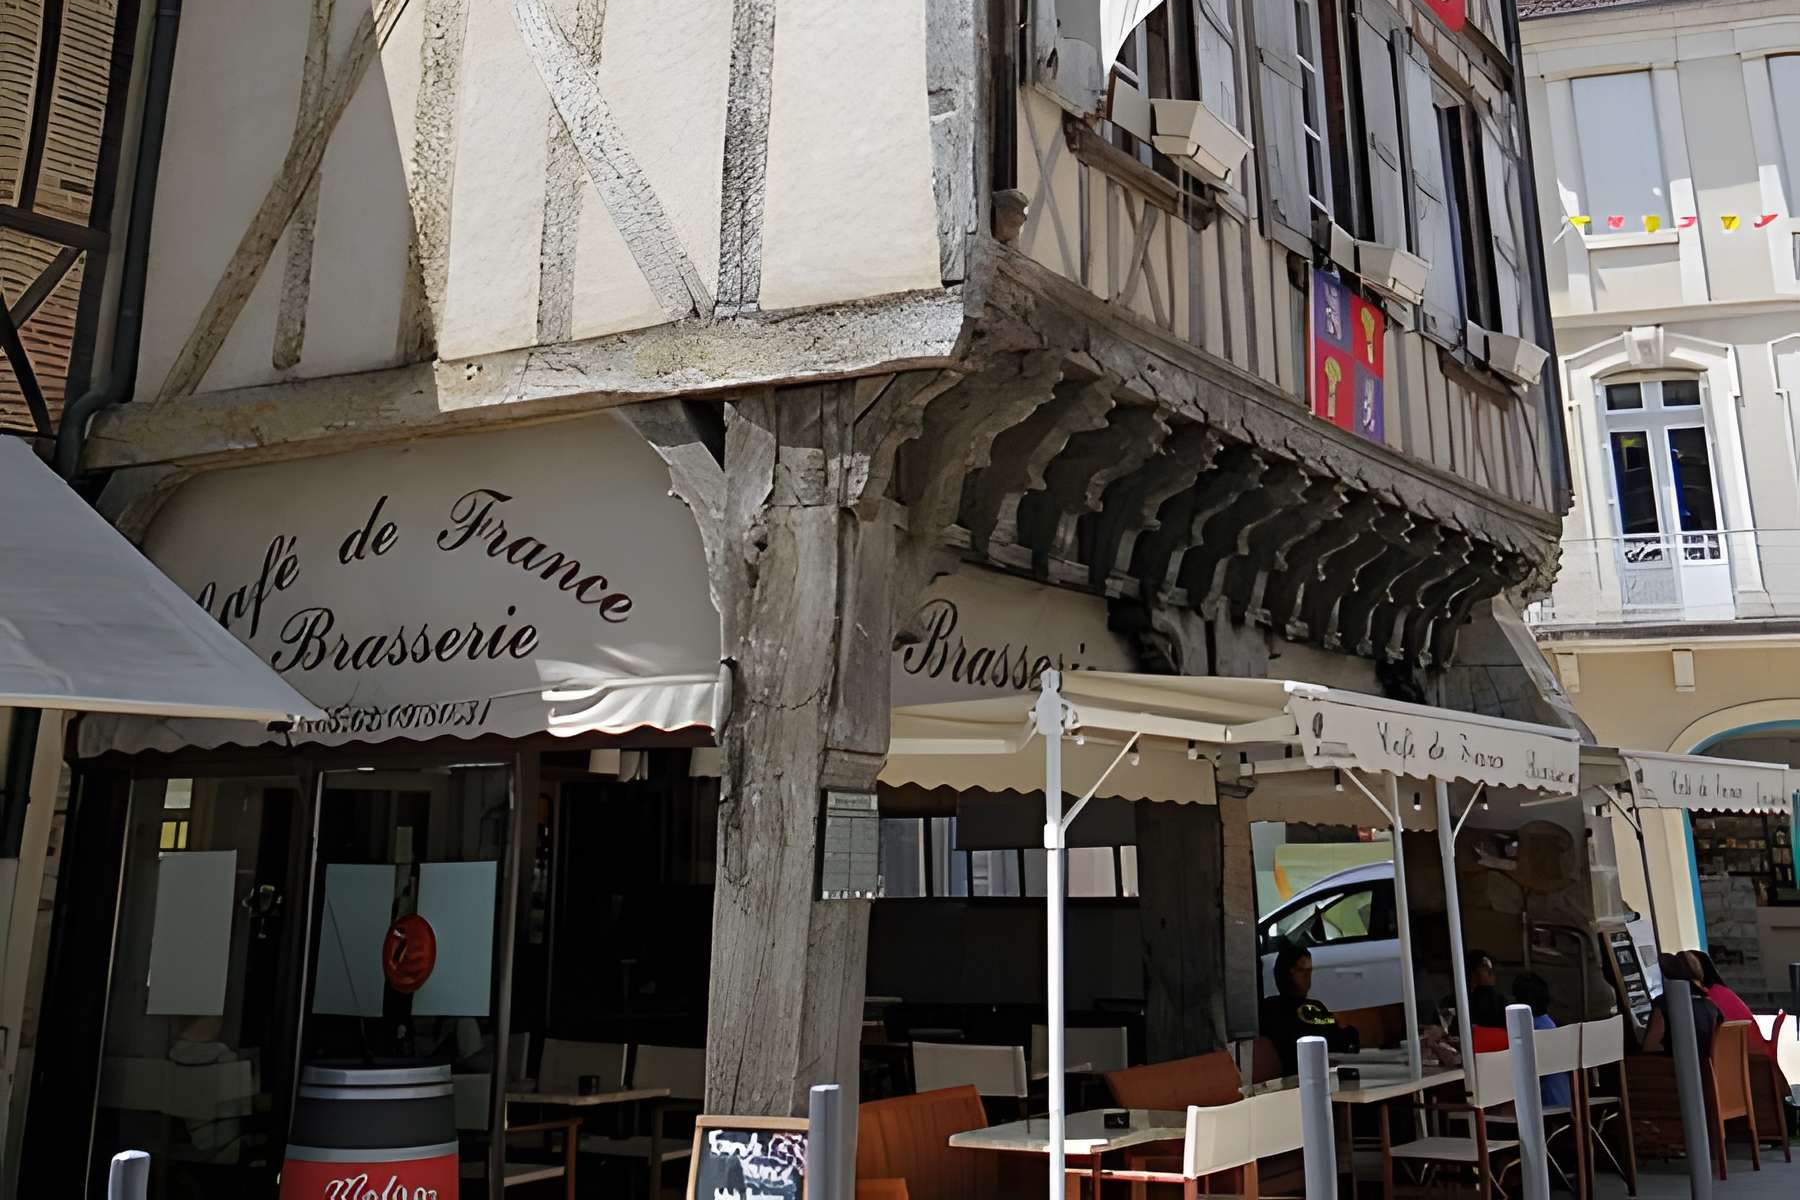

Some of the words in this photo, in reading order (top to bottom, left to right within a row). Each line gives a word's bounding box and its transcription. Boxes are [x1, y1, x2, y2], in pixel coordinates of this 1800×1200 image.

[338, 495, 398, 564] de
[436, 488, 633, 624] France
[271, 605, 539, 672] Brasserie
[903, 599, 1097, 692] Brasse
